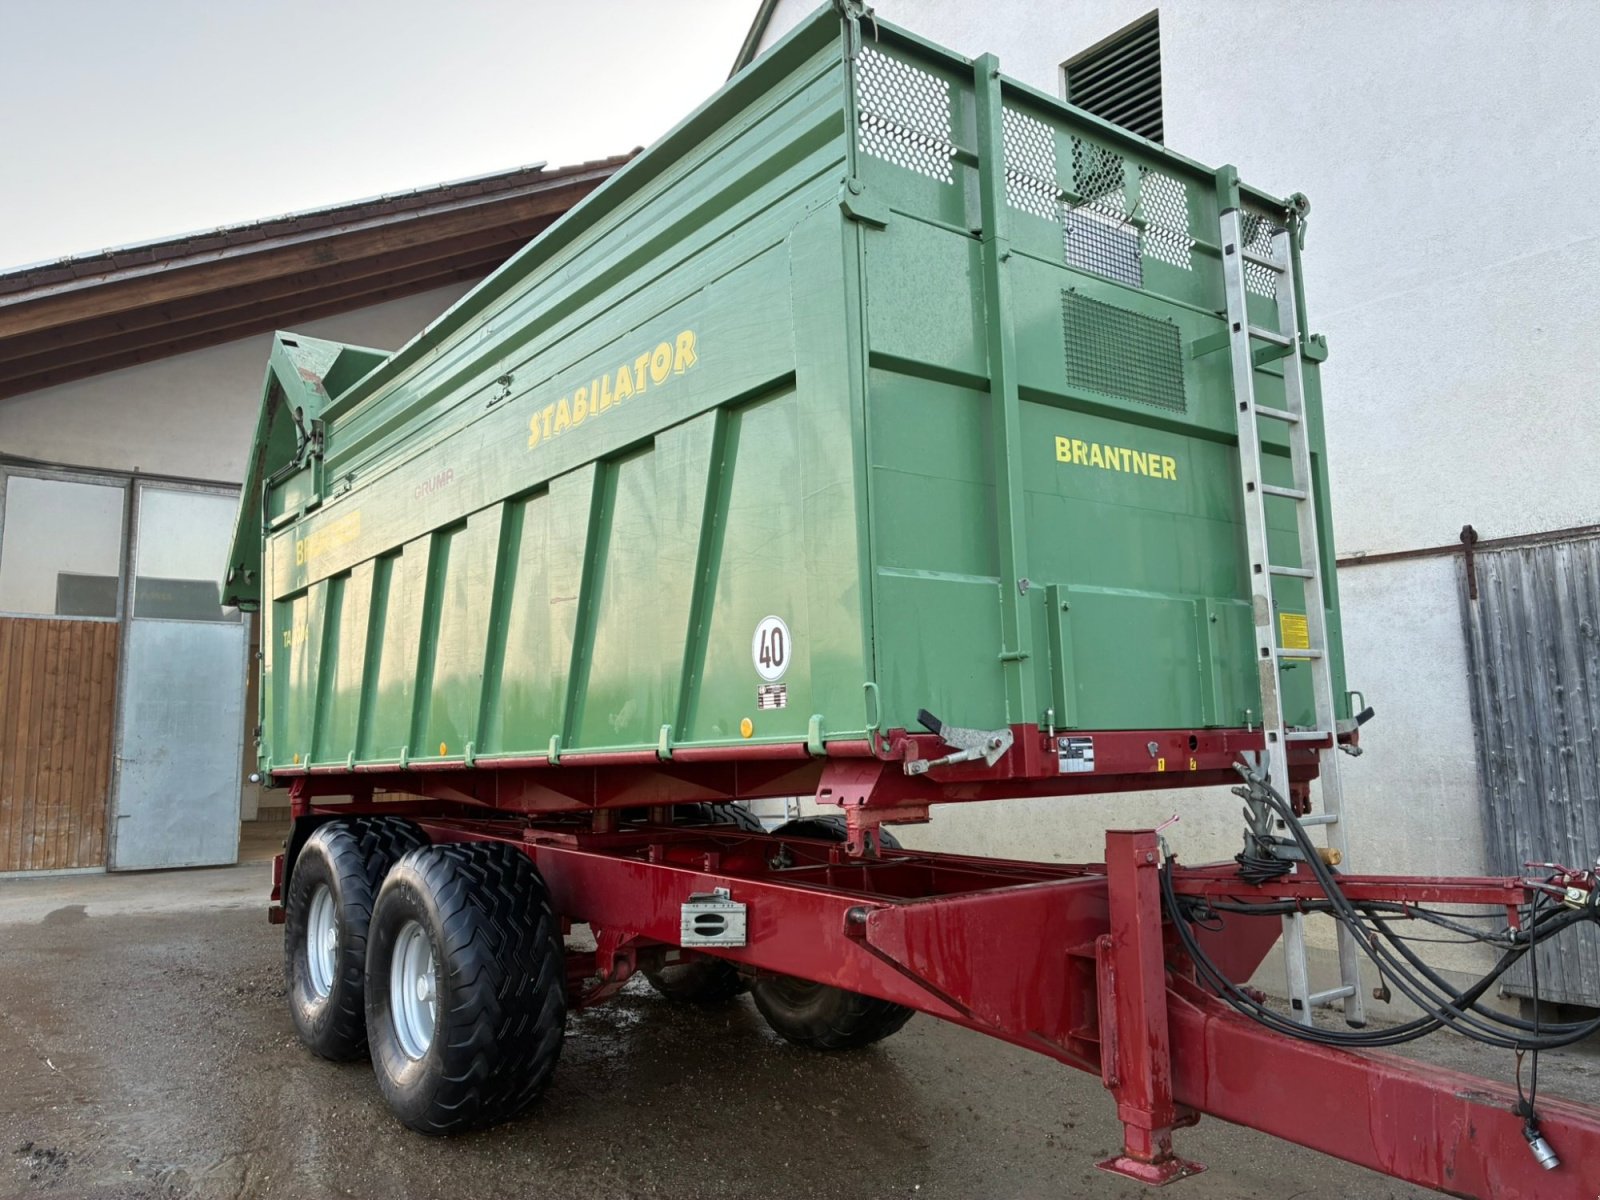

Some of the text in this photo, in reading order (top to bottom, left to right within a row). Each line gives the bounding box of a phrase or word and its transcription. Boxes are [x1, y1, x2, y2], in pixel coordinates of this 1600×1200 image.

[527, 329, 698, 449] STABILATOR
[1055, 436, 1177, 481] BRANTNER
[759, 627, 784, 669] 40
